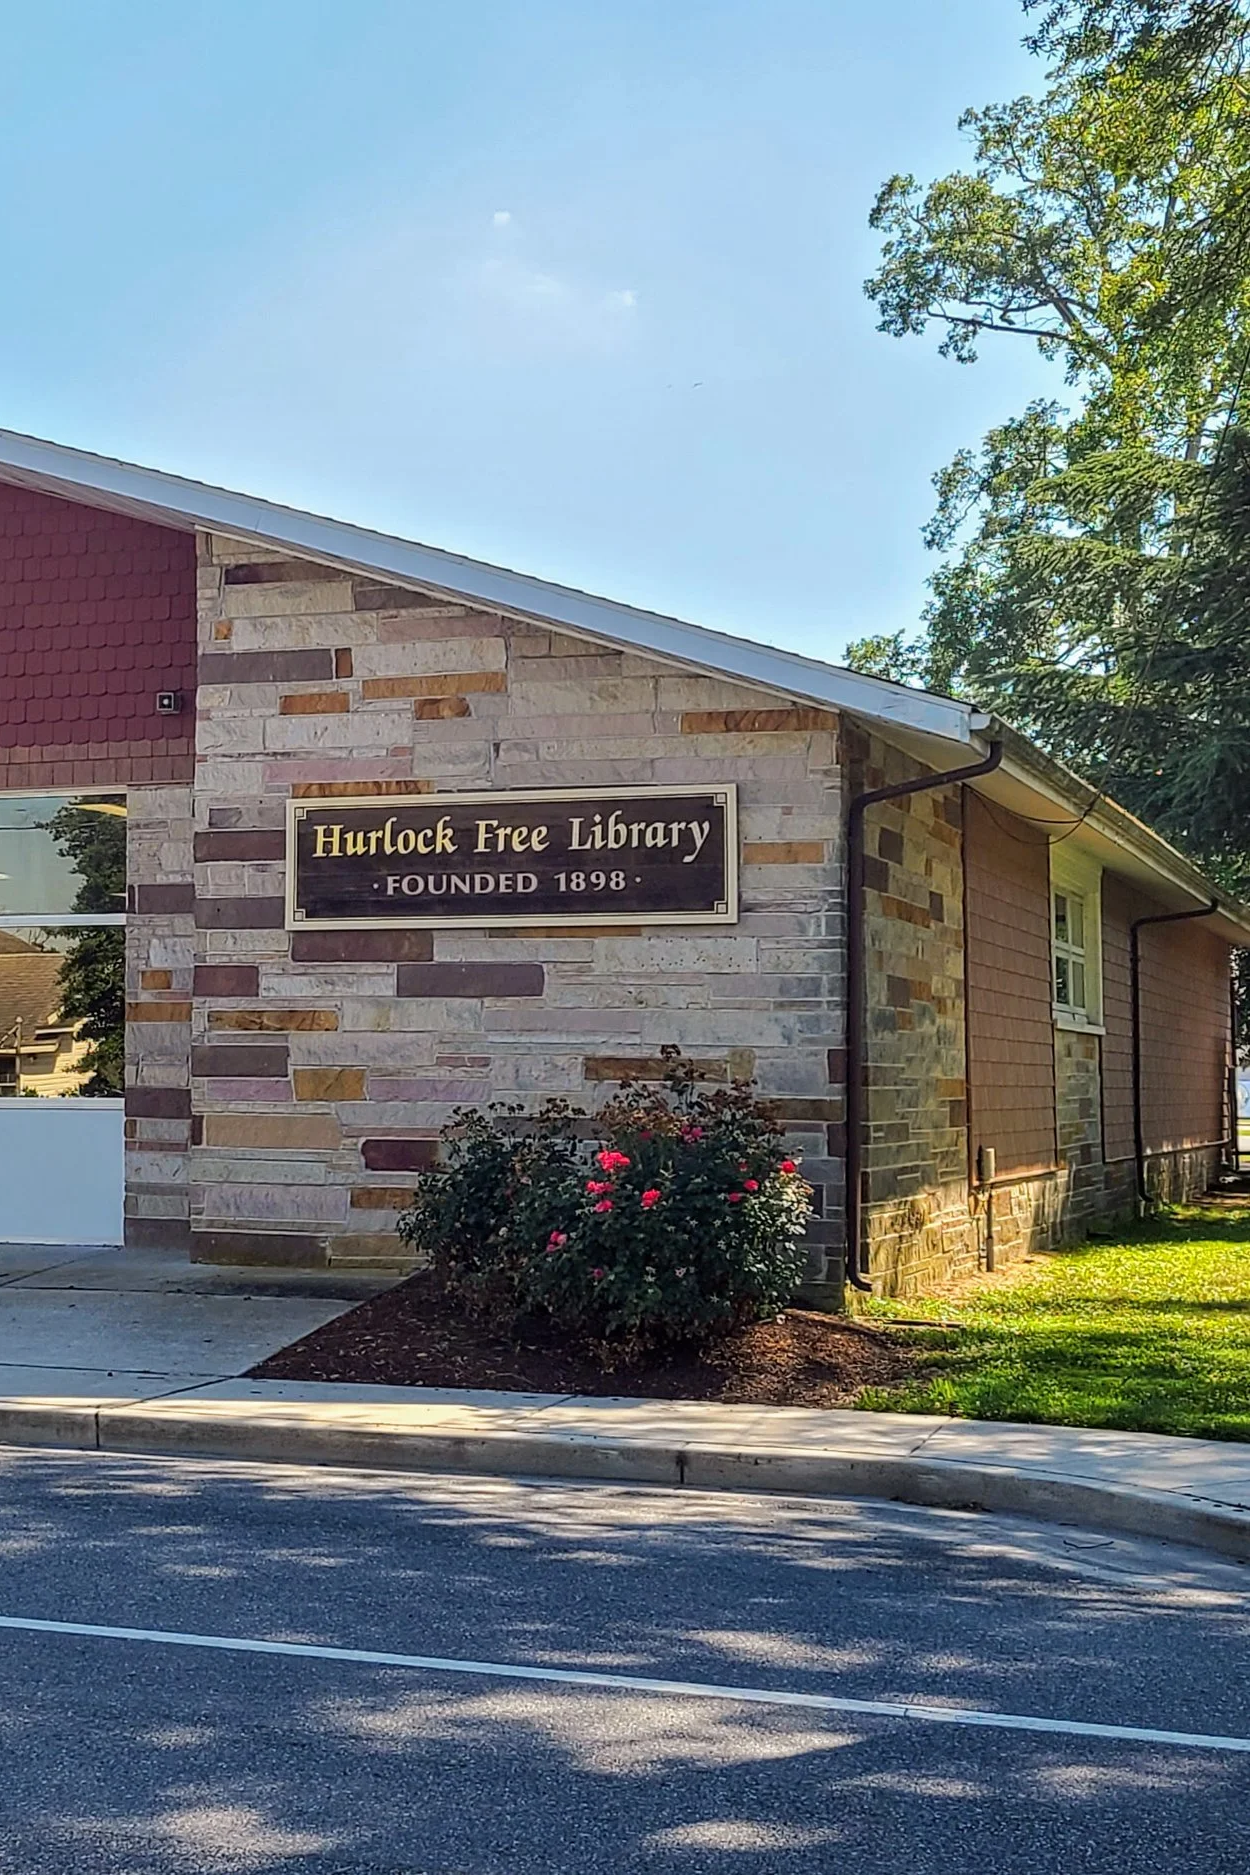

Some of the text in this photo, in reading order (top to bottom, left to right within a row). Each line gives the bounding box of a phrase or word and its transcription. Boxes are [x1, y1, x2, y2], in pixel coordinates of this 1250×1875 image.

[312, 810, 710, 863] Hurlock Free Library
[386, 870, 626, 896] FOUNDED 1898
